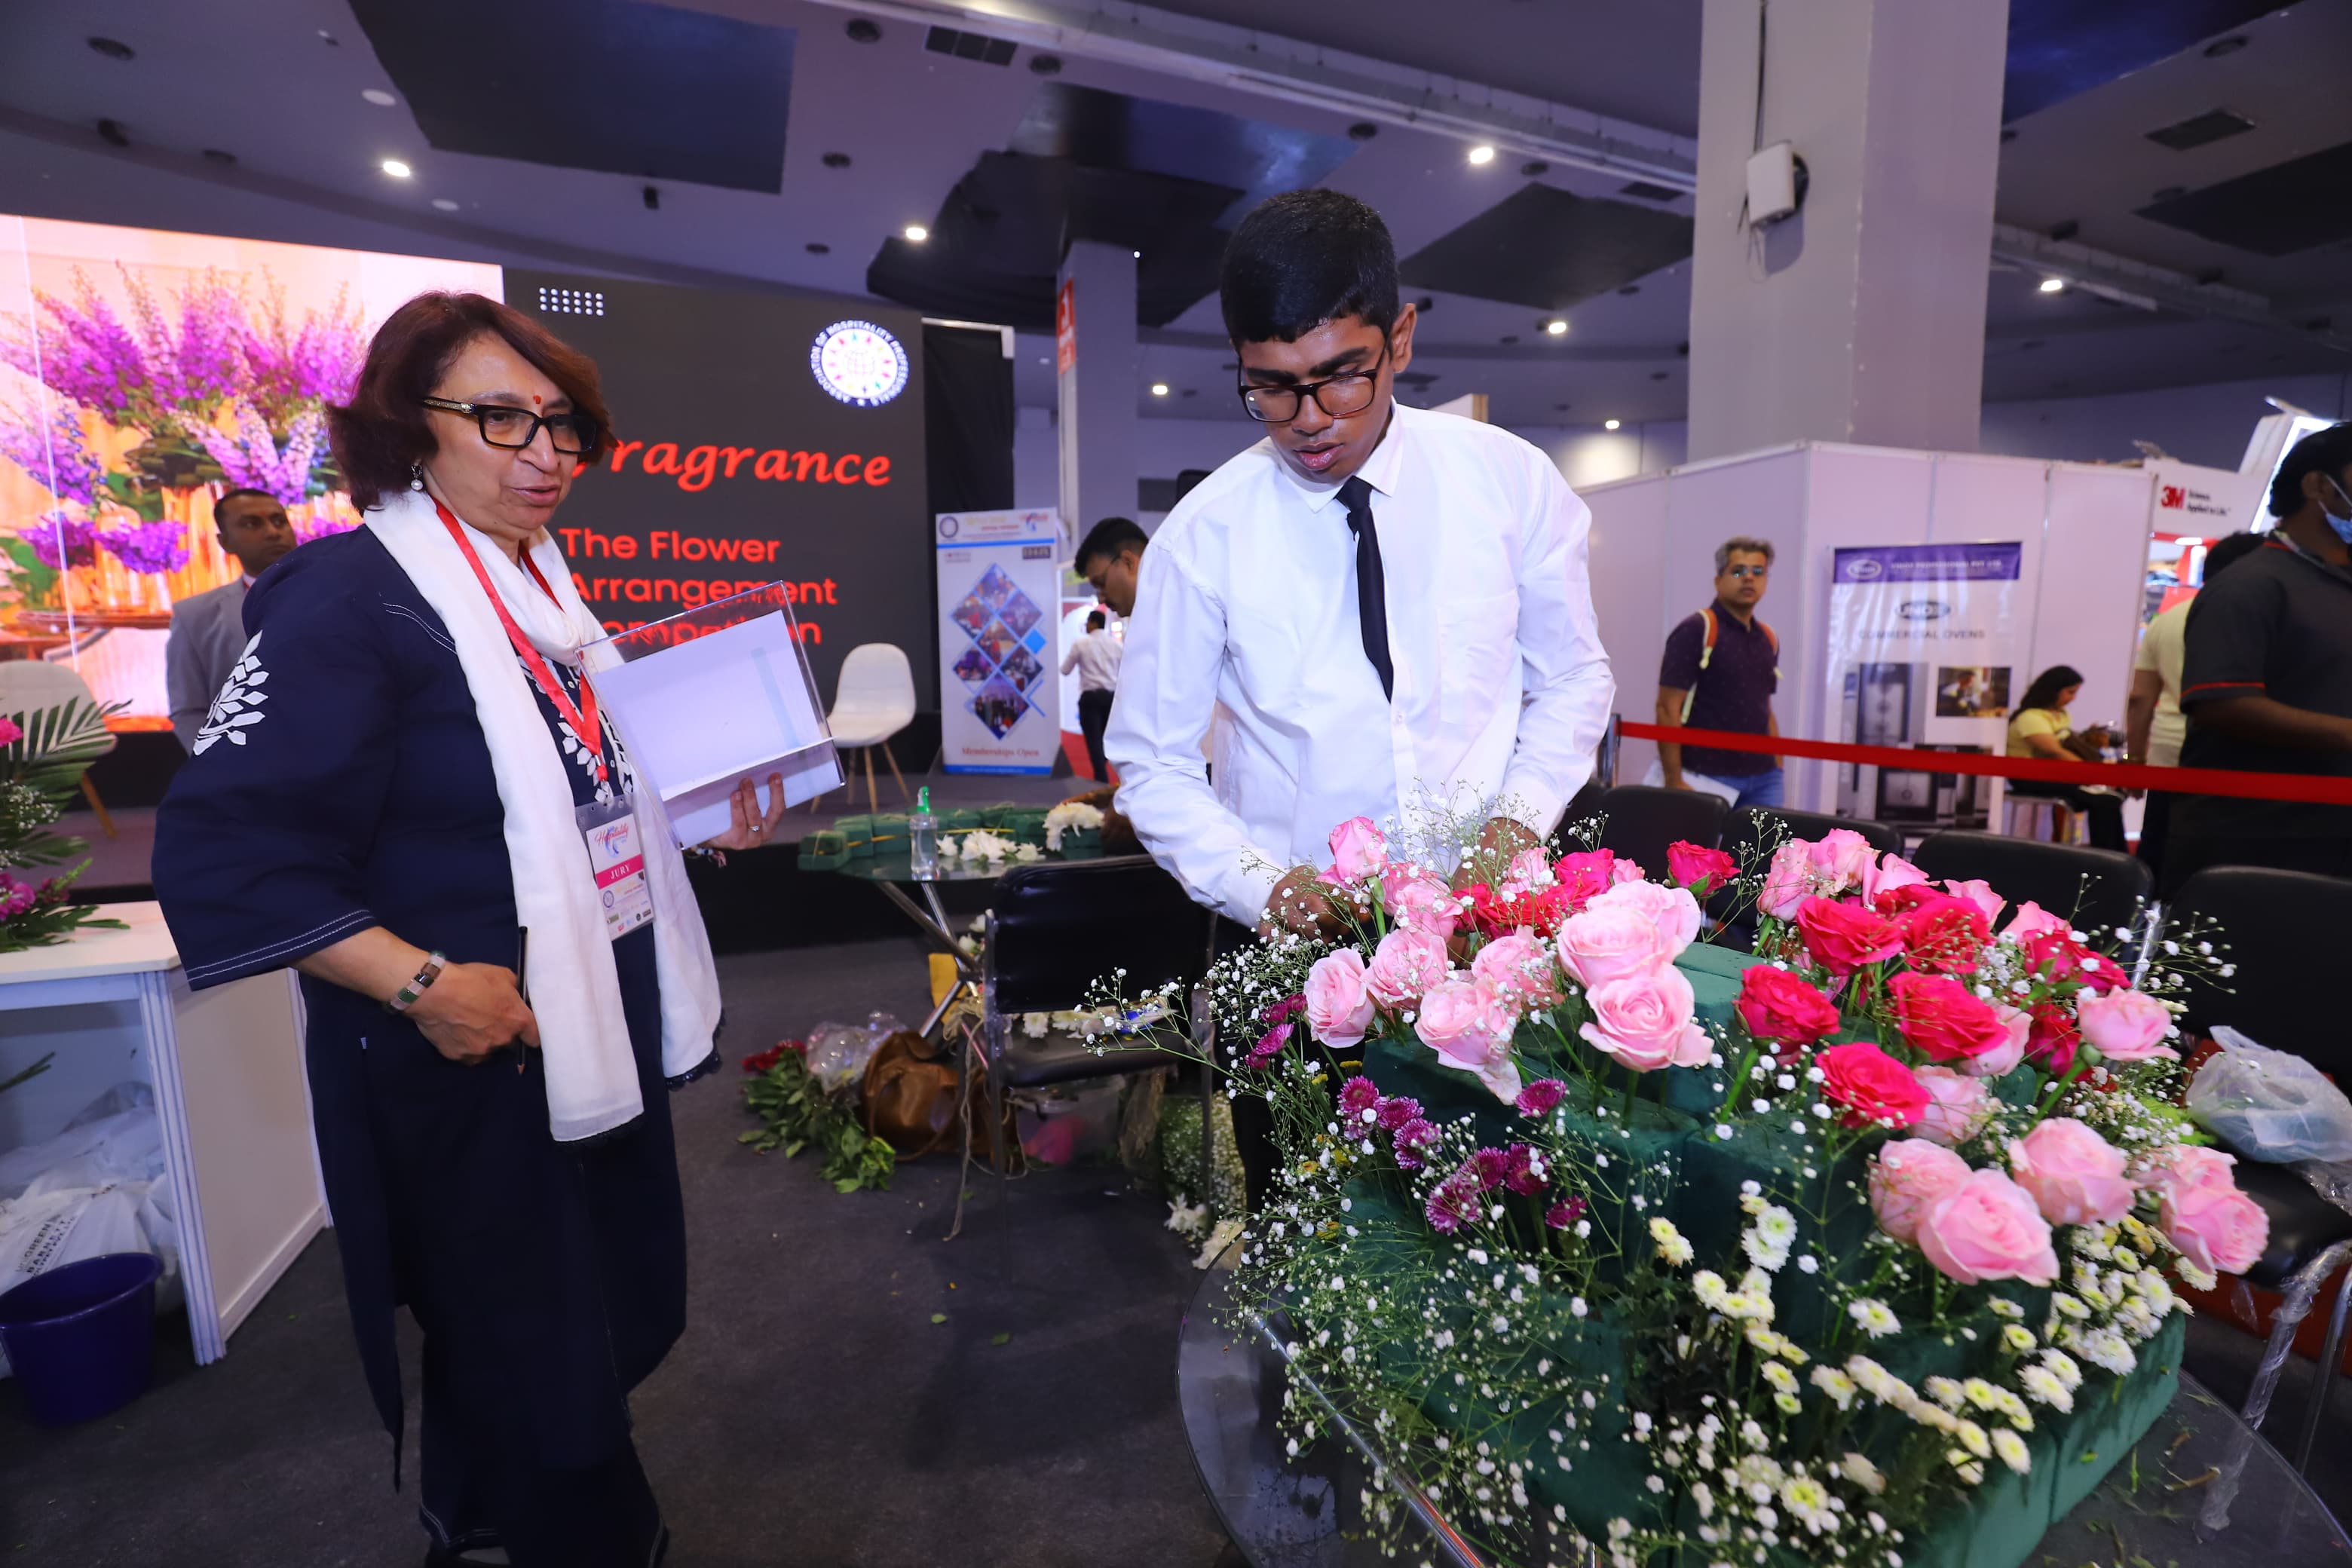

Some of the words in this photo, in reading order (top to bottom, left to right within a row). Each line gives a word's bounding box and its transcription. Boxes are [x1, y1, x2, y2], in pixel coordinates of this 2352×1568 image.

[826, 320, 894, 342] HOSPITALITY
[572, 439, 891, 492] ragrance
[2161, 485, 2185, 510] 3M
[559, 528, 639, 559] The
[650, 530, 781, 562] Flower
[571, 572, 838, 608] Arrangement
[609, 864, 630, 880] JURY
